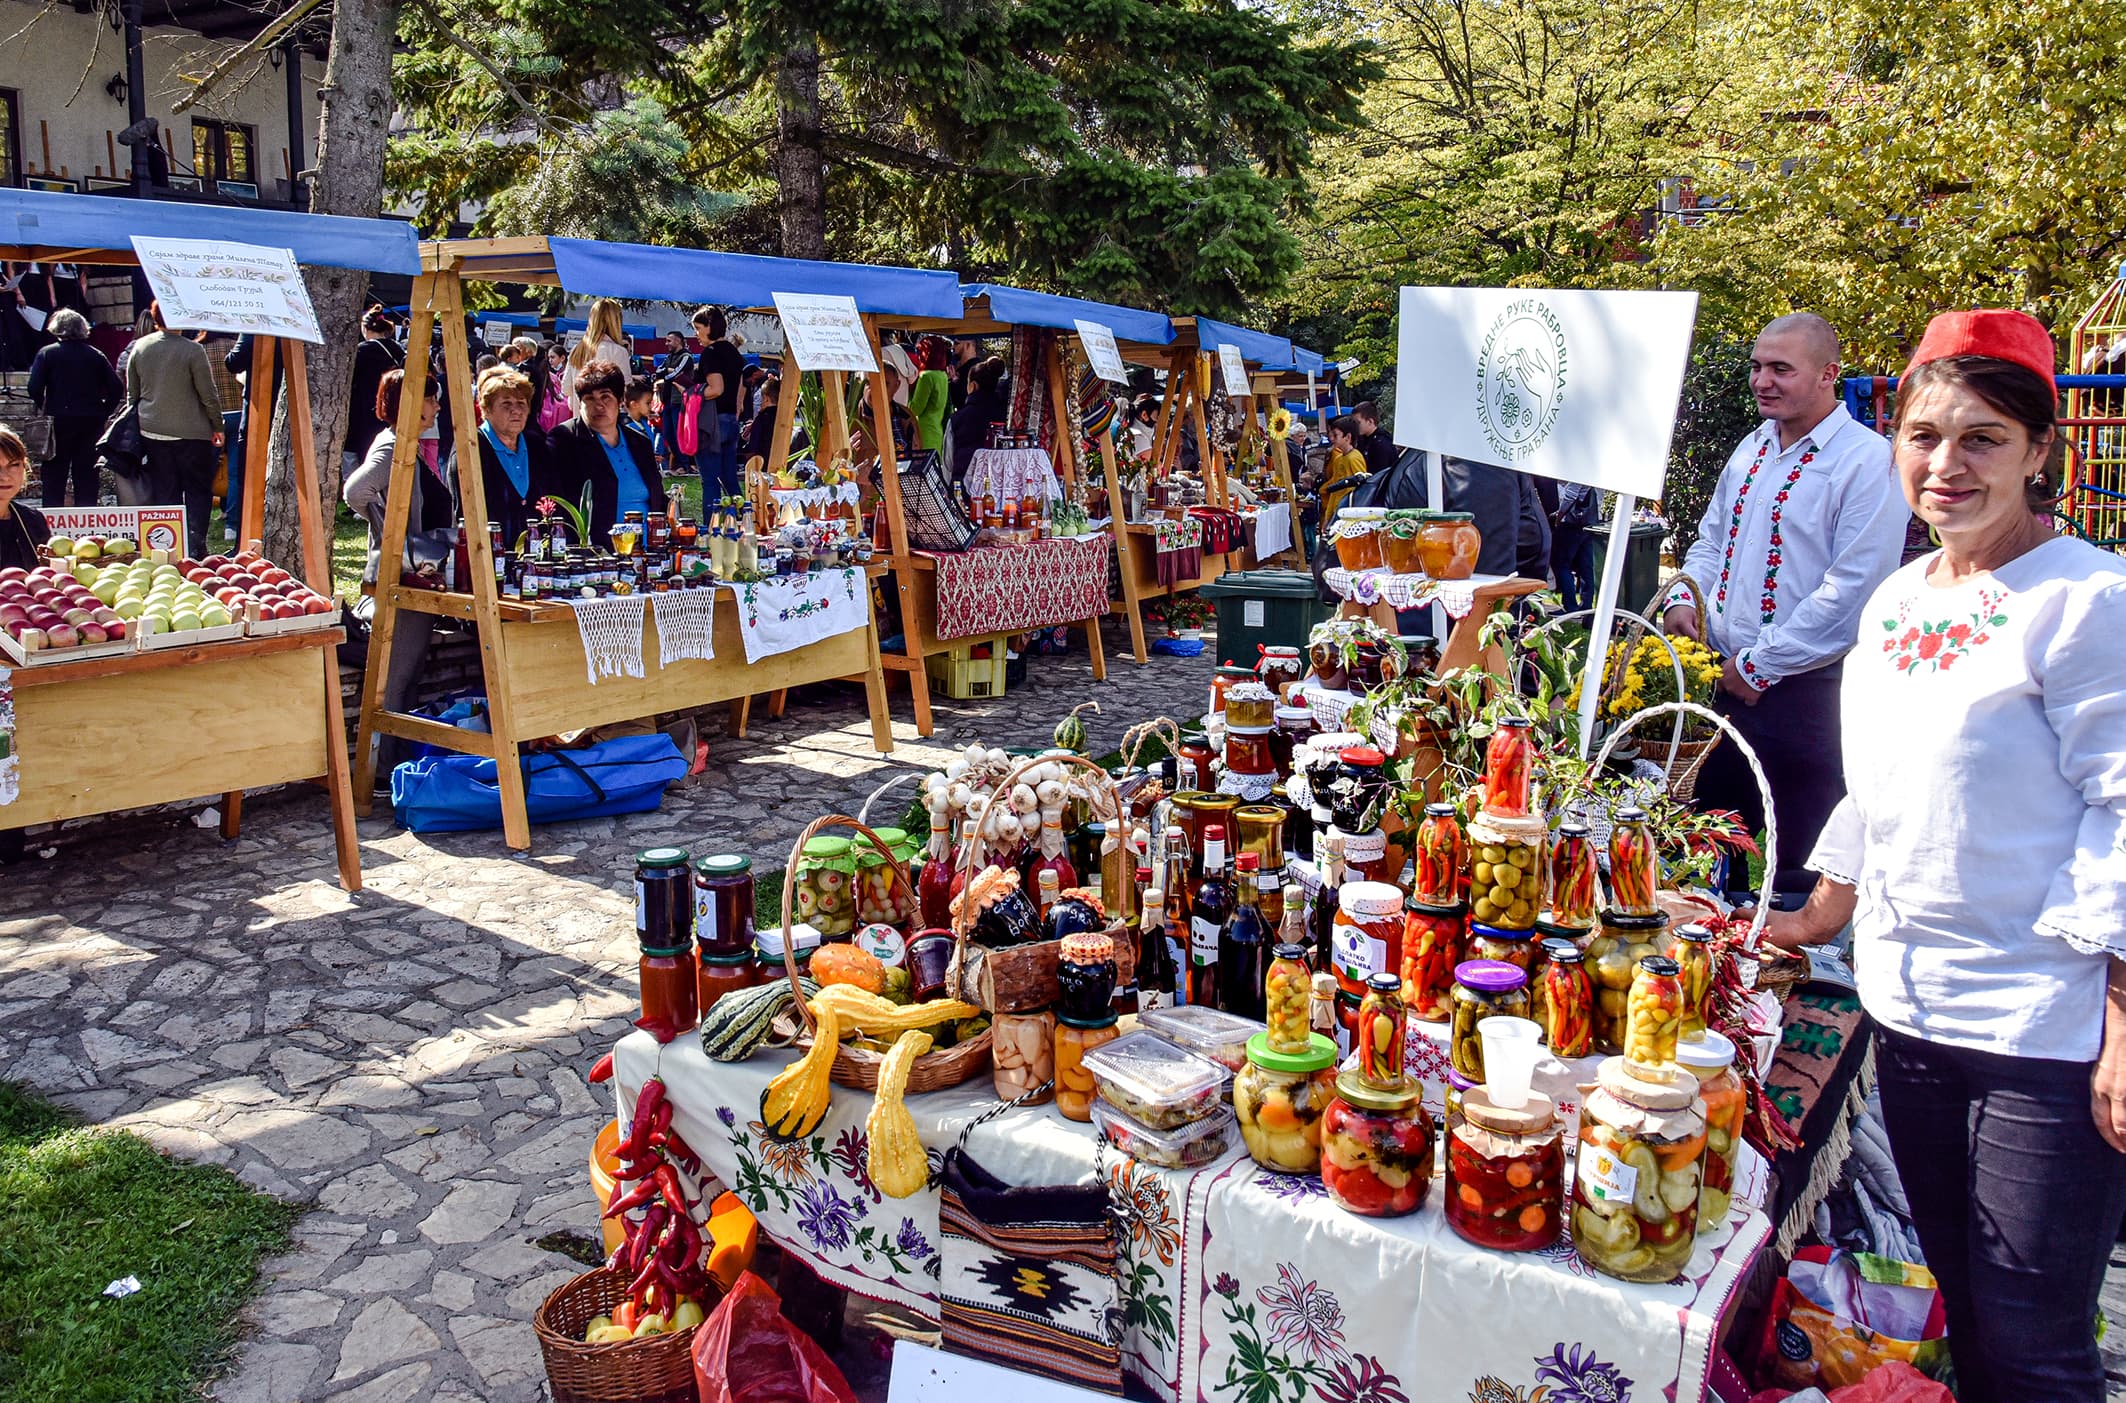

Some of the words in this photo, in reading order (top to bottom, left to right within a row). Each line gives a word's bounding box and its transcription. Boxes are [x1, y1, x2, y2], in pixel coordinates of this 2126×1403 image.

[1476, 312, 1504, 378] ВРЕДНЕ
[1506, 299, 1534, 317] РУКЕ
[1537, 302, 1568, 389] РАБРОВЦА
[46, 513, 135, 529] RANJENO!!!
[141, 511, 180, 521] PAŽNJA!
